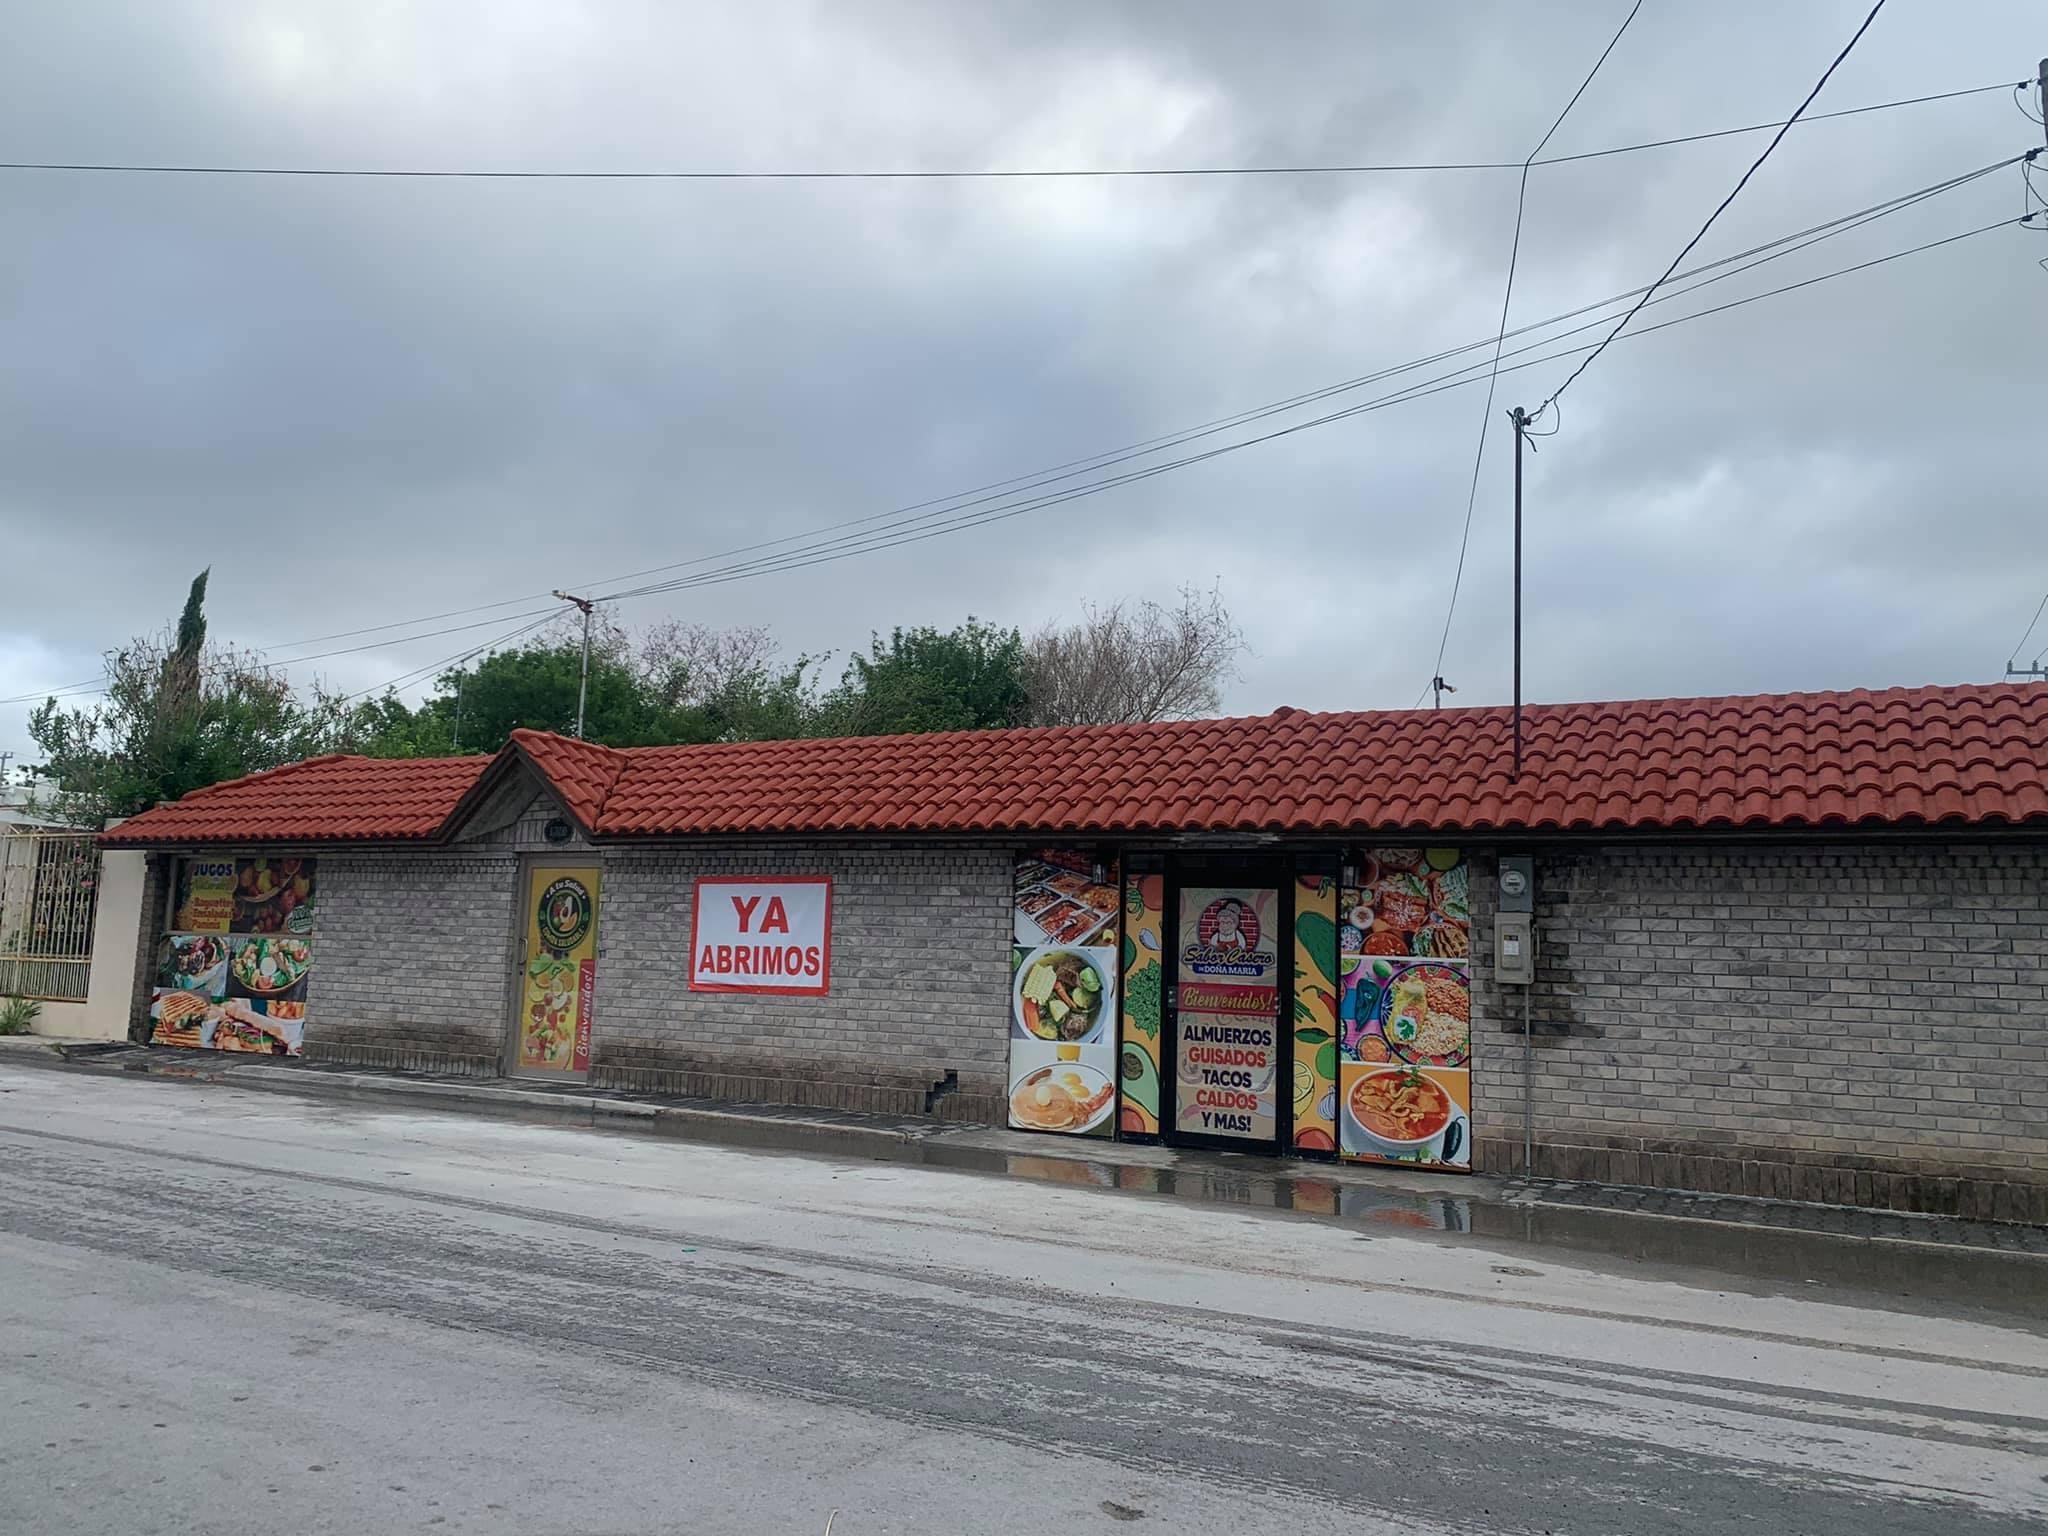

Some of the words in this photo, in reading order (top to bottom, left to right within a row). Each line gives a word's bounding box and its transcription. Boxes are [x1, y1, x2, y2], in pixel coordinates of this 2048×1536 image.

[194, 863, 233, 877] JUGOS
[564, 880, 585, 896] Salud
[731, 896, 789, 933] YA
[699, 945, 820, 976] ABRIMOS
[1183, 945, 1224, 964] Sabor
[1223, 946, 1275, 965] Casero
[1183, 986, 1274, 1010] Bienvenidos!
[576, 967, 593, 1057] Bienvenidos!
[1184, 1025, 1272, 1046] ALMUERZOS
[1188, 1046, 1267, 1068] GUISADOS
[1202, 1069, 1252, 1088] TACOS
[1196, 1088, 1258, 1110] CALDOS
[1201, 1112, 1212, 1128] Y
[1214, 1113, 1252, 1132] MAS!
